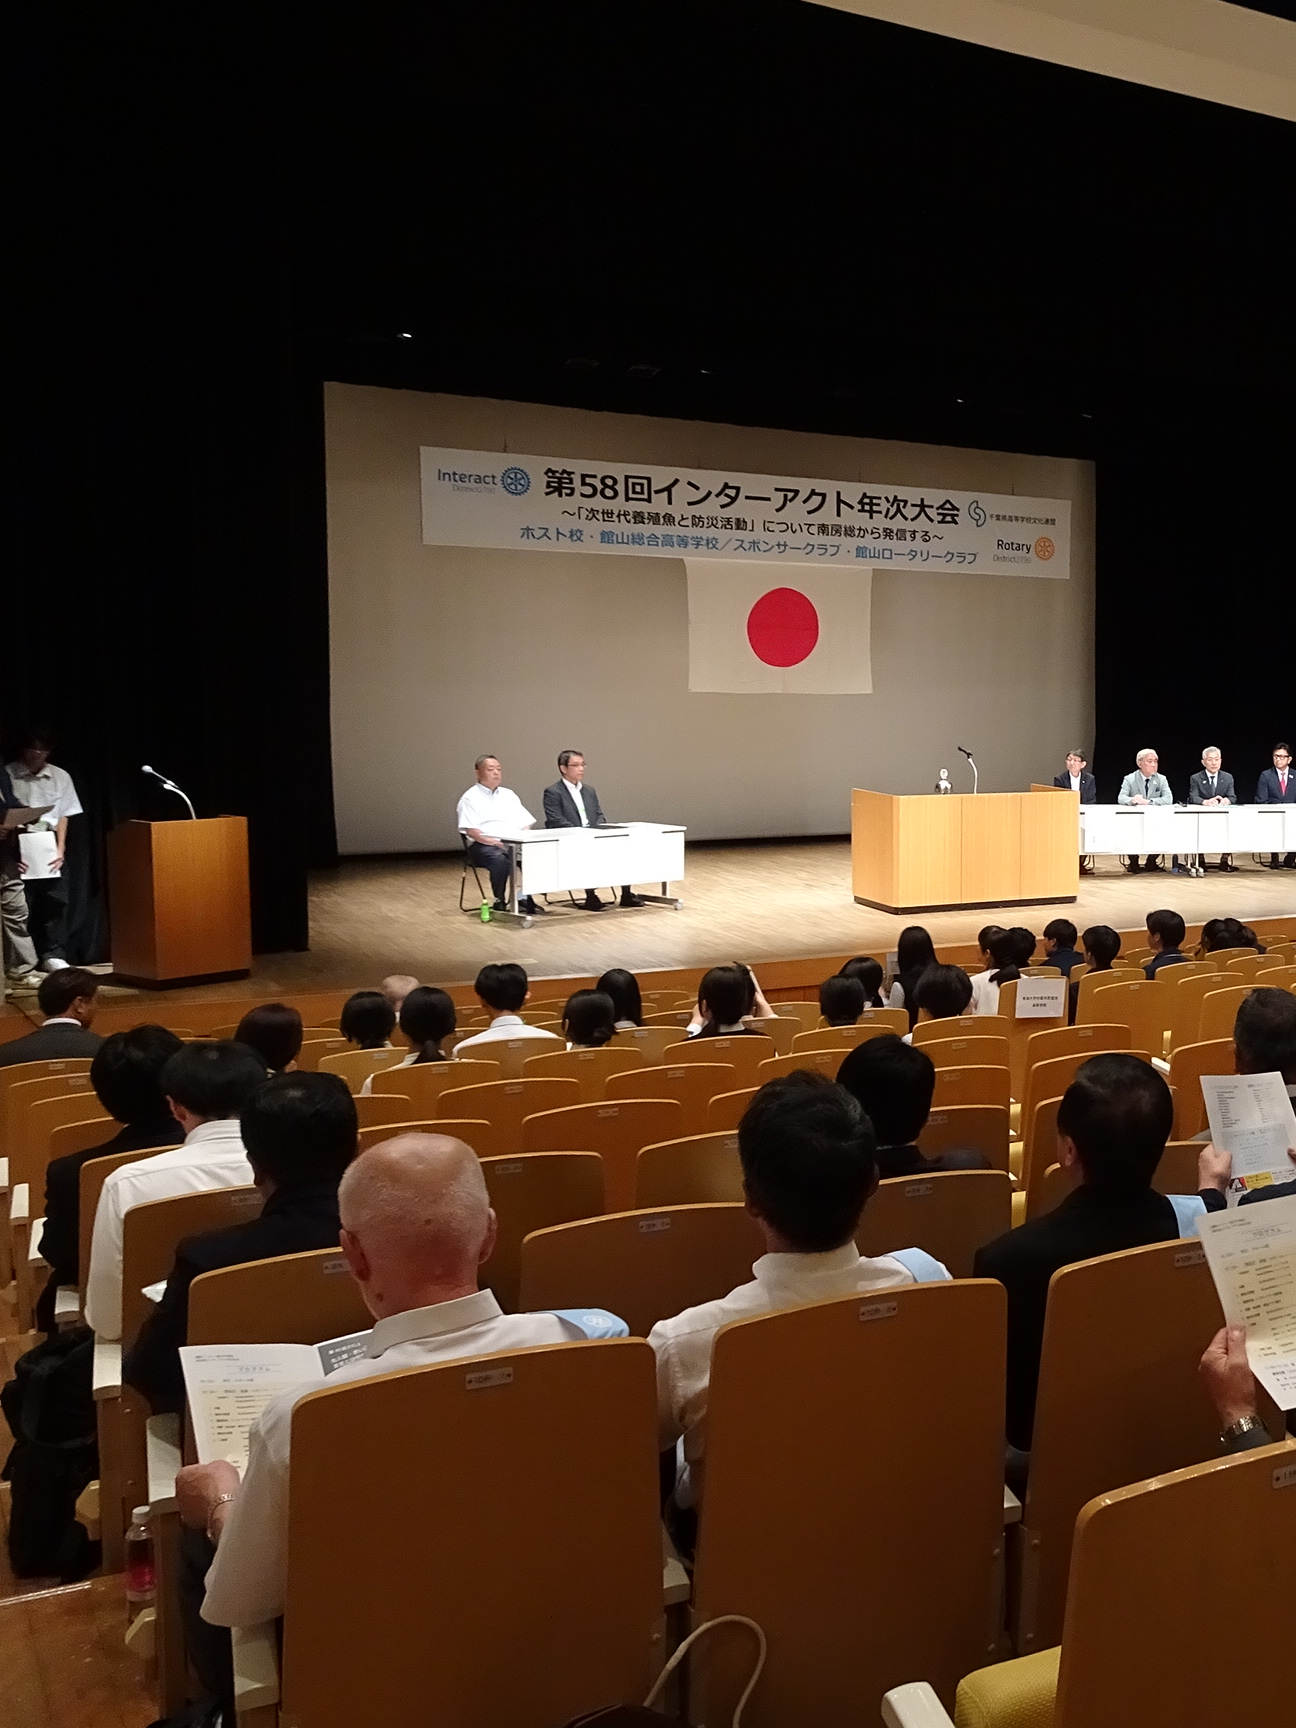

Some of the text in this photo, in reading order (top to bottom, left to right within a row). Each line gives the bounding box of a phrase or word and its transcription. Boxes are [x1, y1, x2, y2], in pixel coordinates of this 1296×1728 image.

[437, 468, 498, 485] Interact
[543, 467, 960, 525] 第58回インターアクト年次大会
[996, 539, 1032, 554] Rotary
